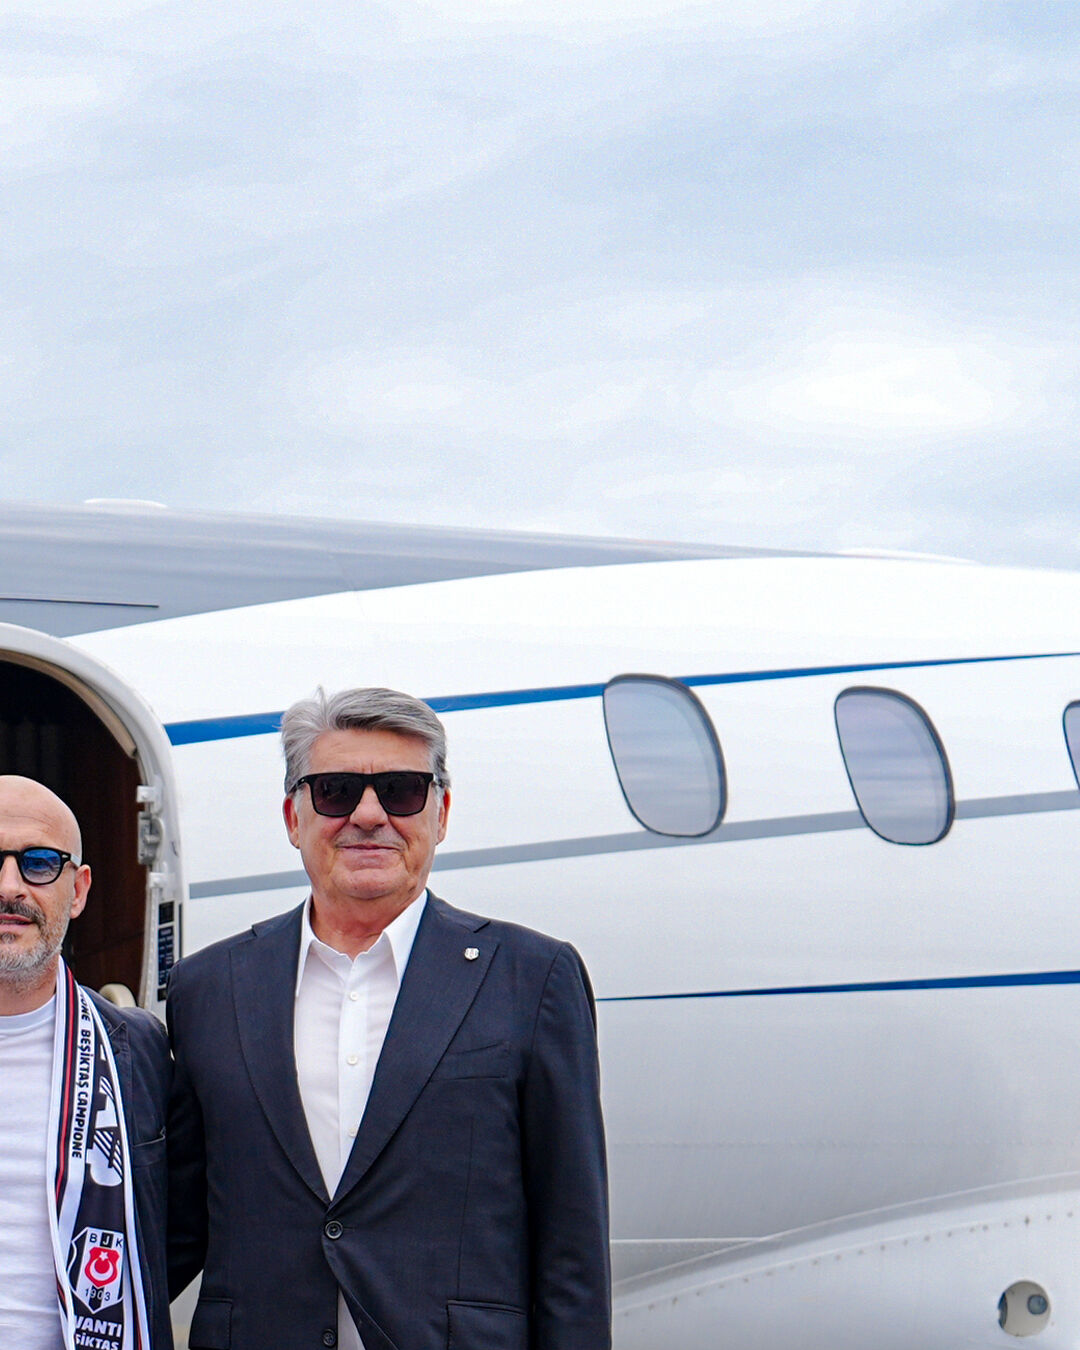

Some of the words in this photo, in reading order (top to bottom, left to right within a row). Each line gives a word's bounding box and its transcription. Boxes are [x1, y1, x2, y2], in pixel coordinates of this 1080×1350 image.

[76, 1029, 94, 1088] BEŞİKTAŞ
[72, 1091, 89, 1159] CAMPIONE
[85, 1287, 111, 1301] 1903
[74, 1315, 123, 1337] VANTI
